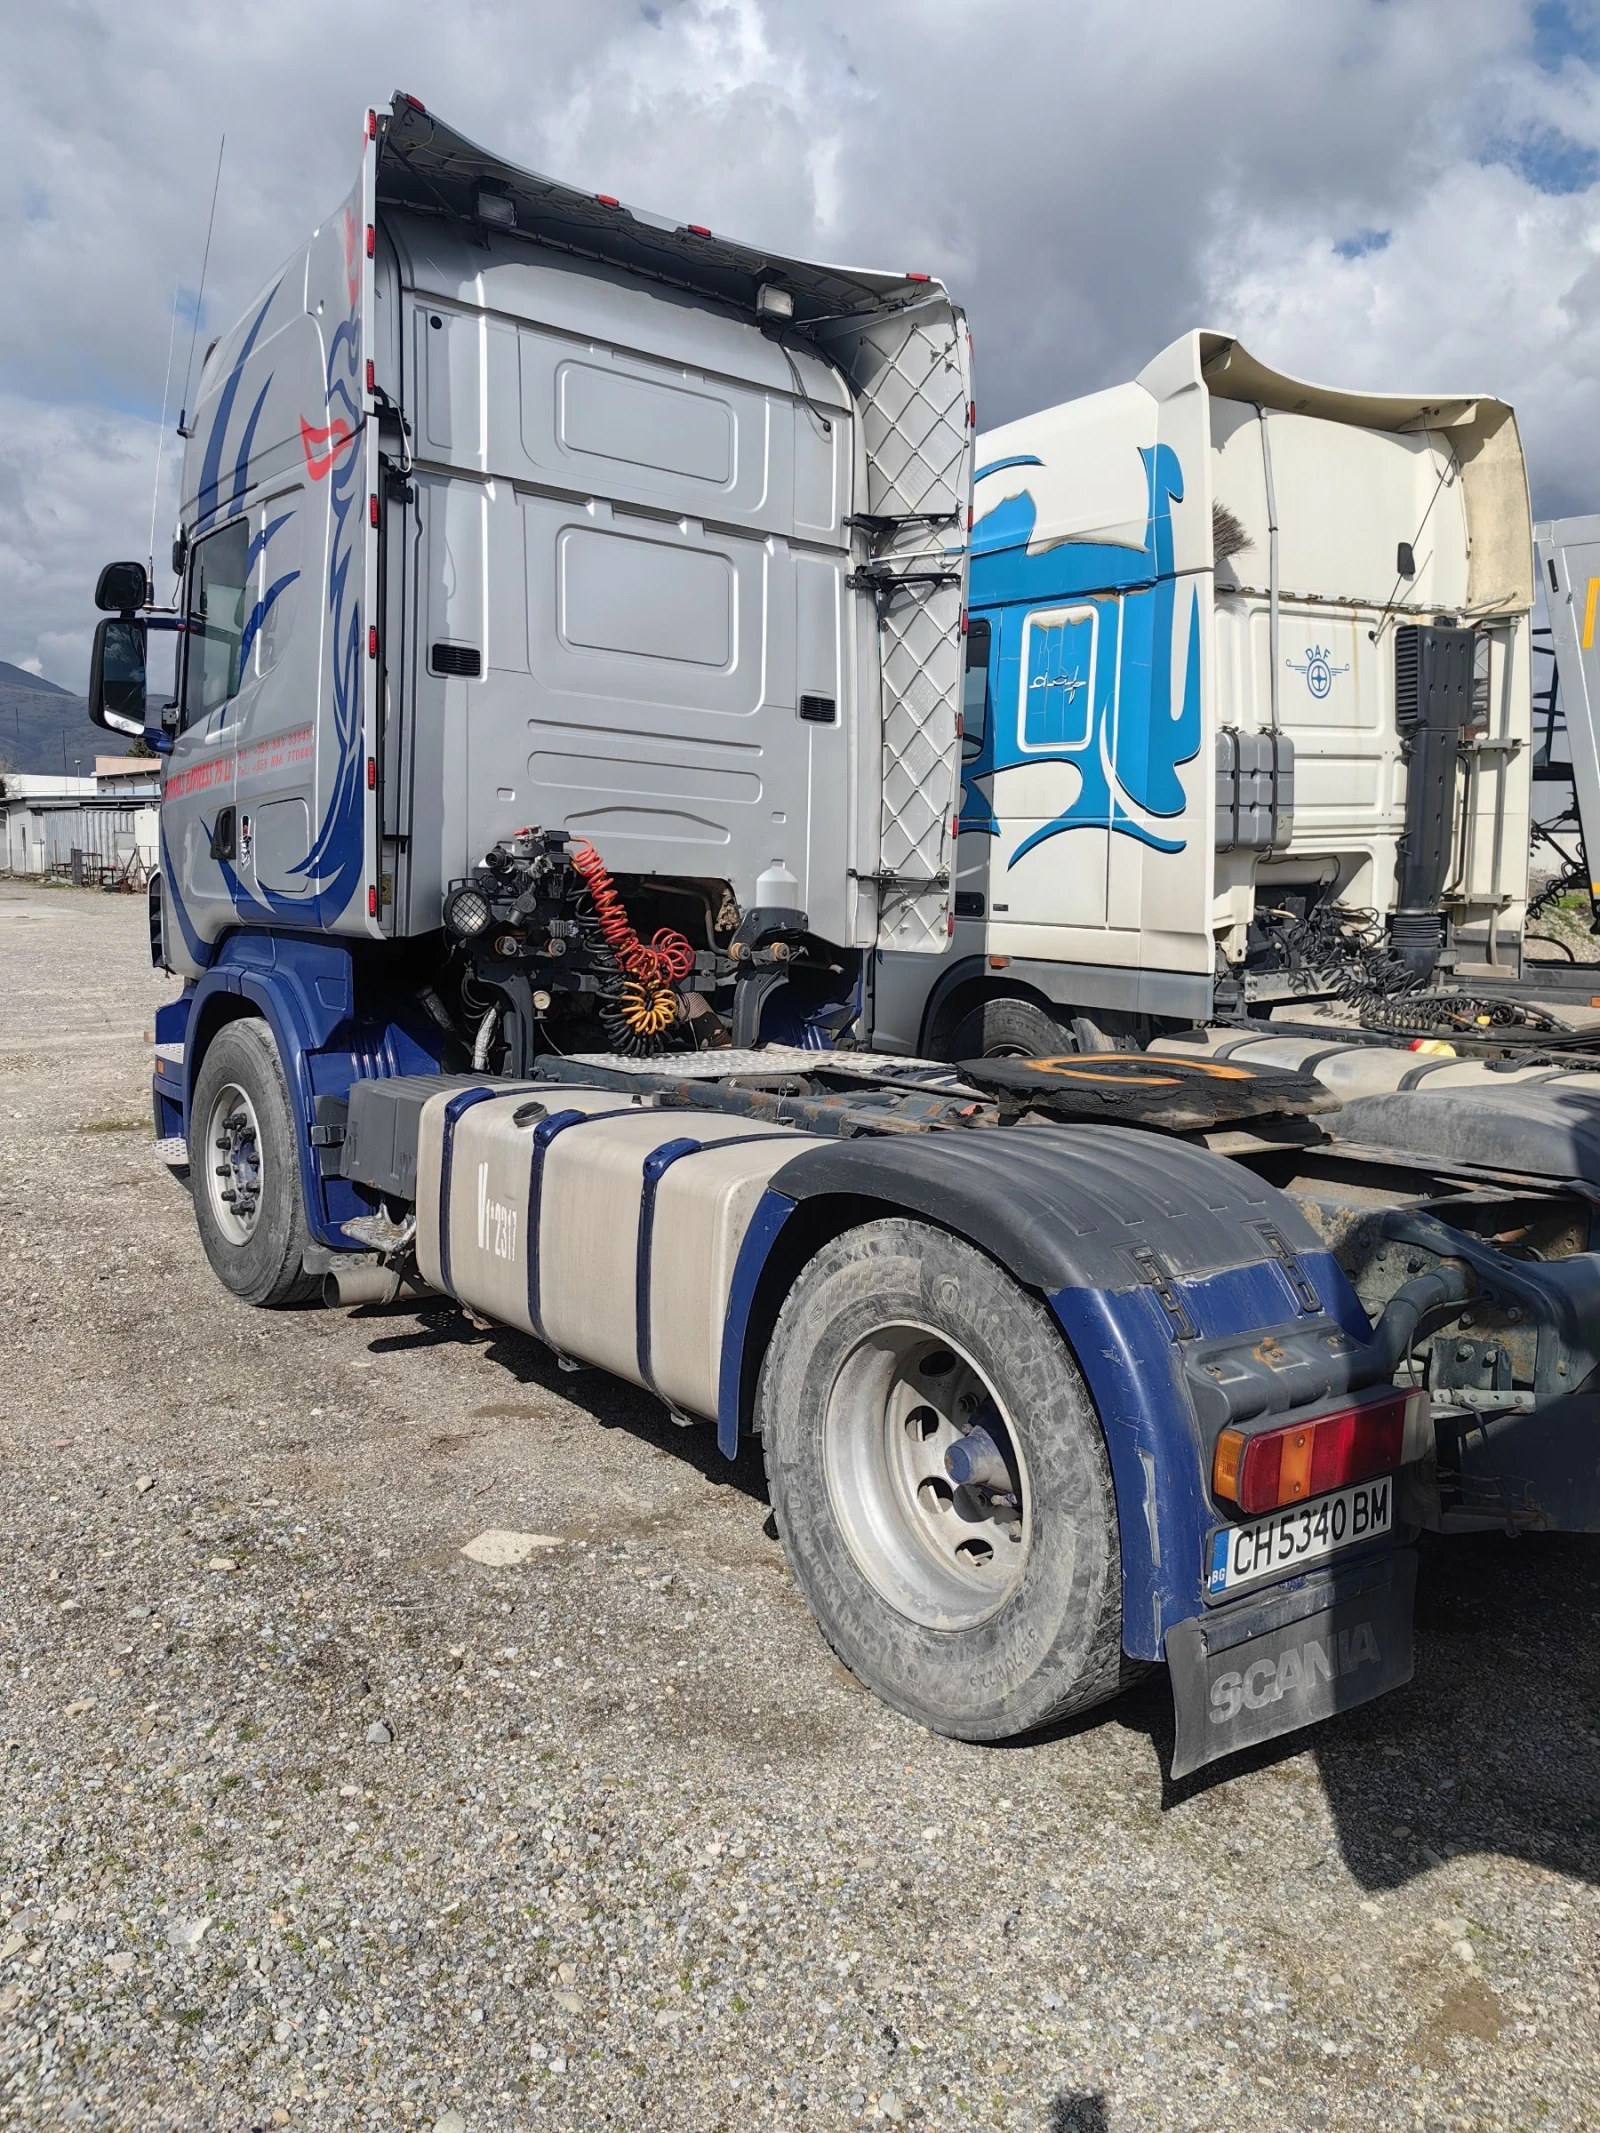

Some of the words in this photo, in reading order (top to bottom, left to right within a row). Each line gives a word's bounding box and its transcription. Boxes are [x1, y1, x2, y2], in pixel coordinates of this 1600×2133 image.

[1305, 644, 1331, 661] DAF
[1211, 1568, 1226, 1585] BG
[1209, 1621, 1382, 1724] SCANIA
